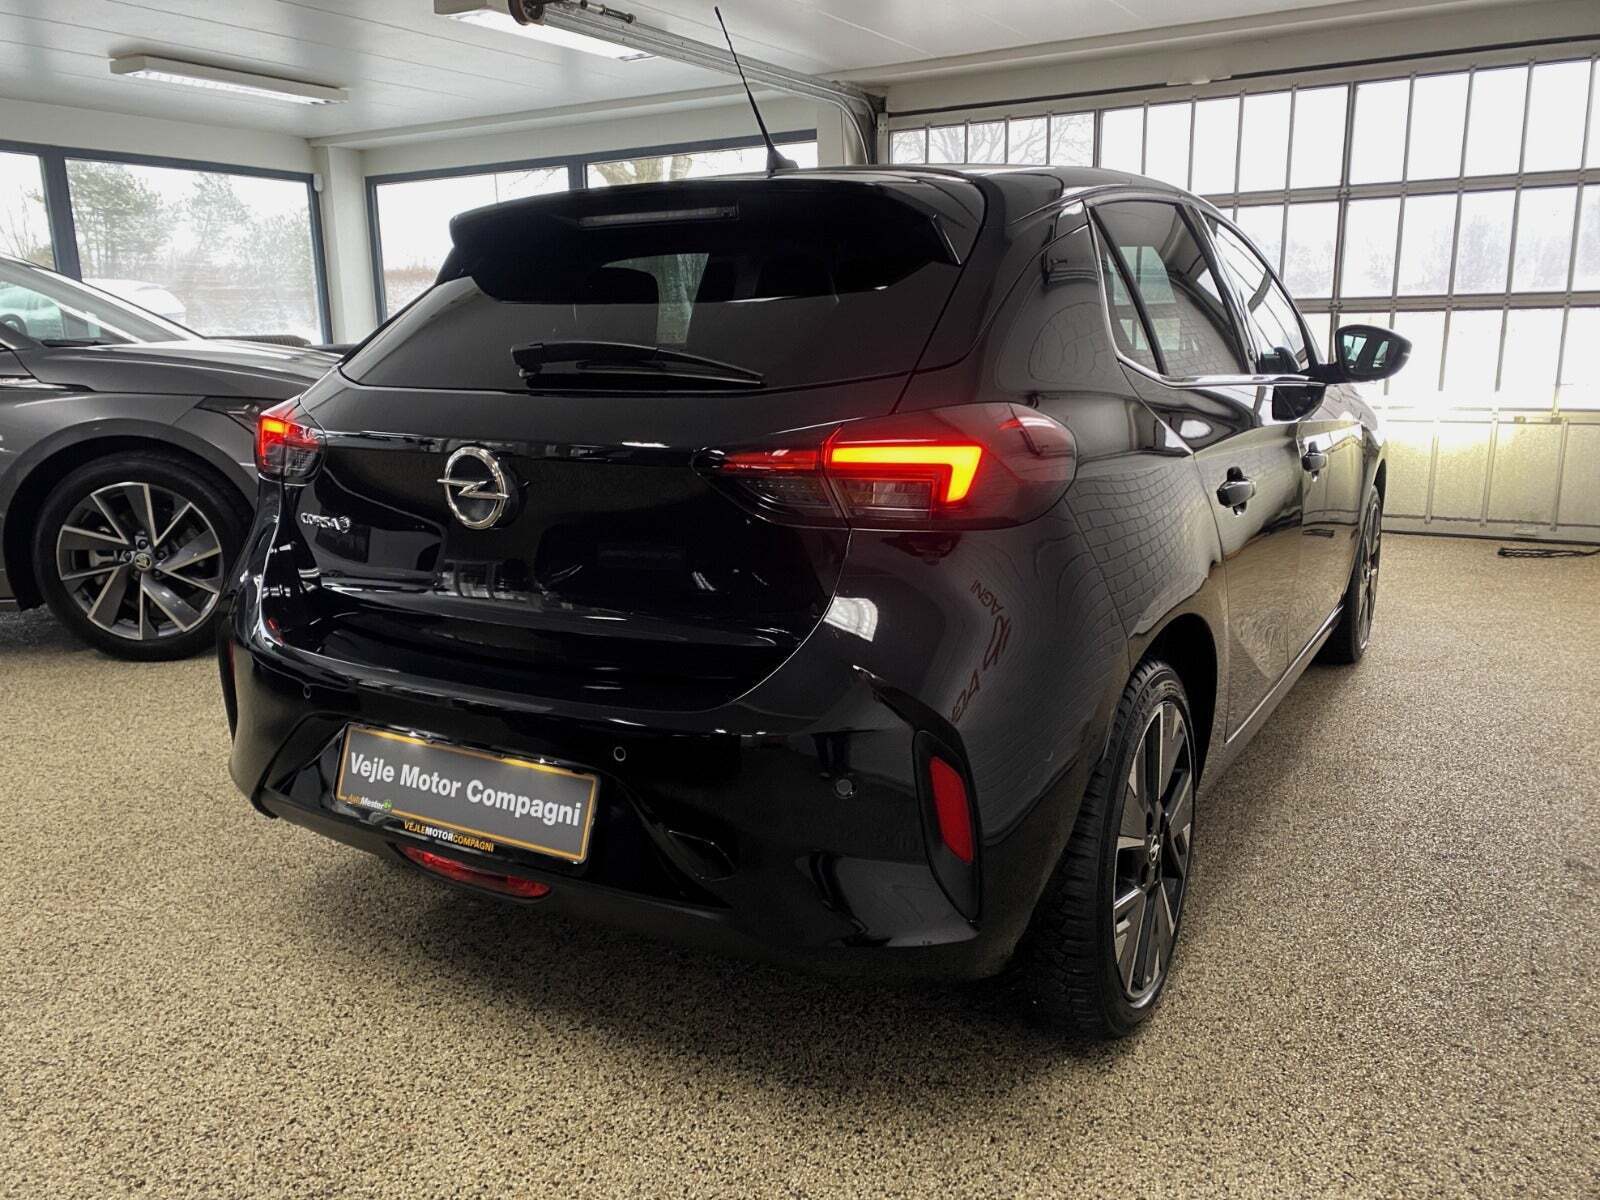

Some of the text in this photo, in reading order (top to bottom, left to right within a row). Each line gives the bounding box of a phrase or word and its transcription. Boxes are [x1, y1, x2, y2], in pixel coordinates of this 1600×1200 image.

[350, 752, 582, 826] Vejle Motor Compagni
